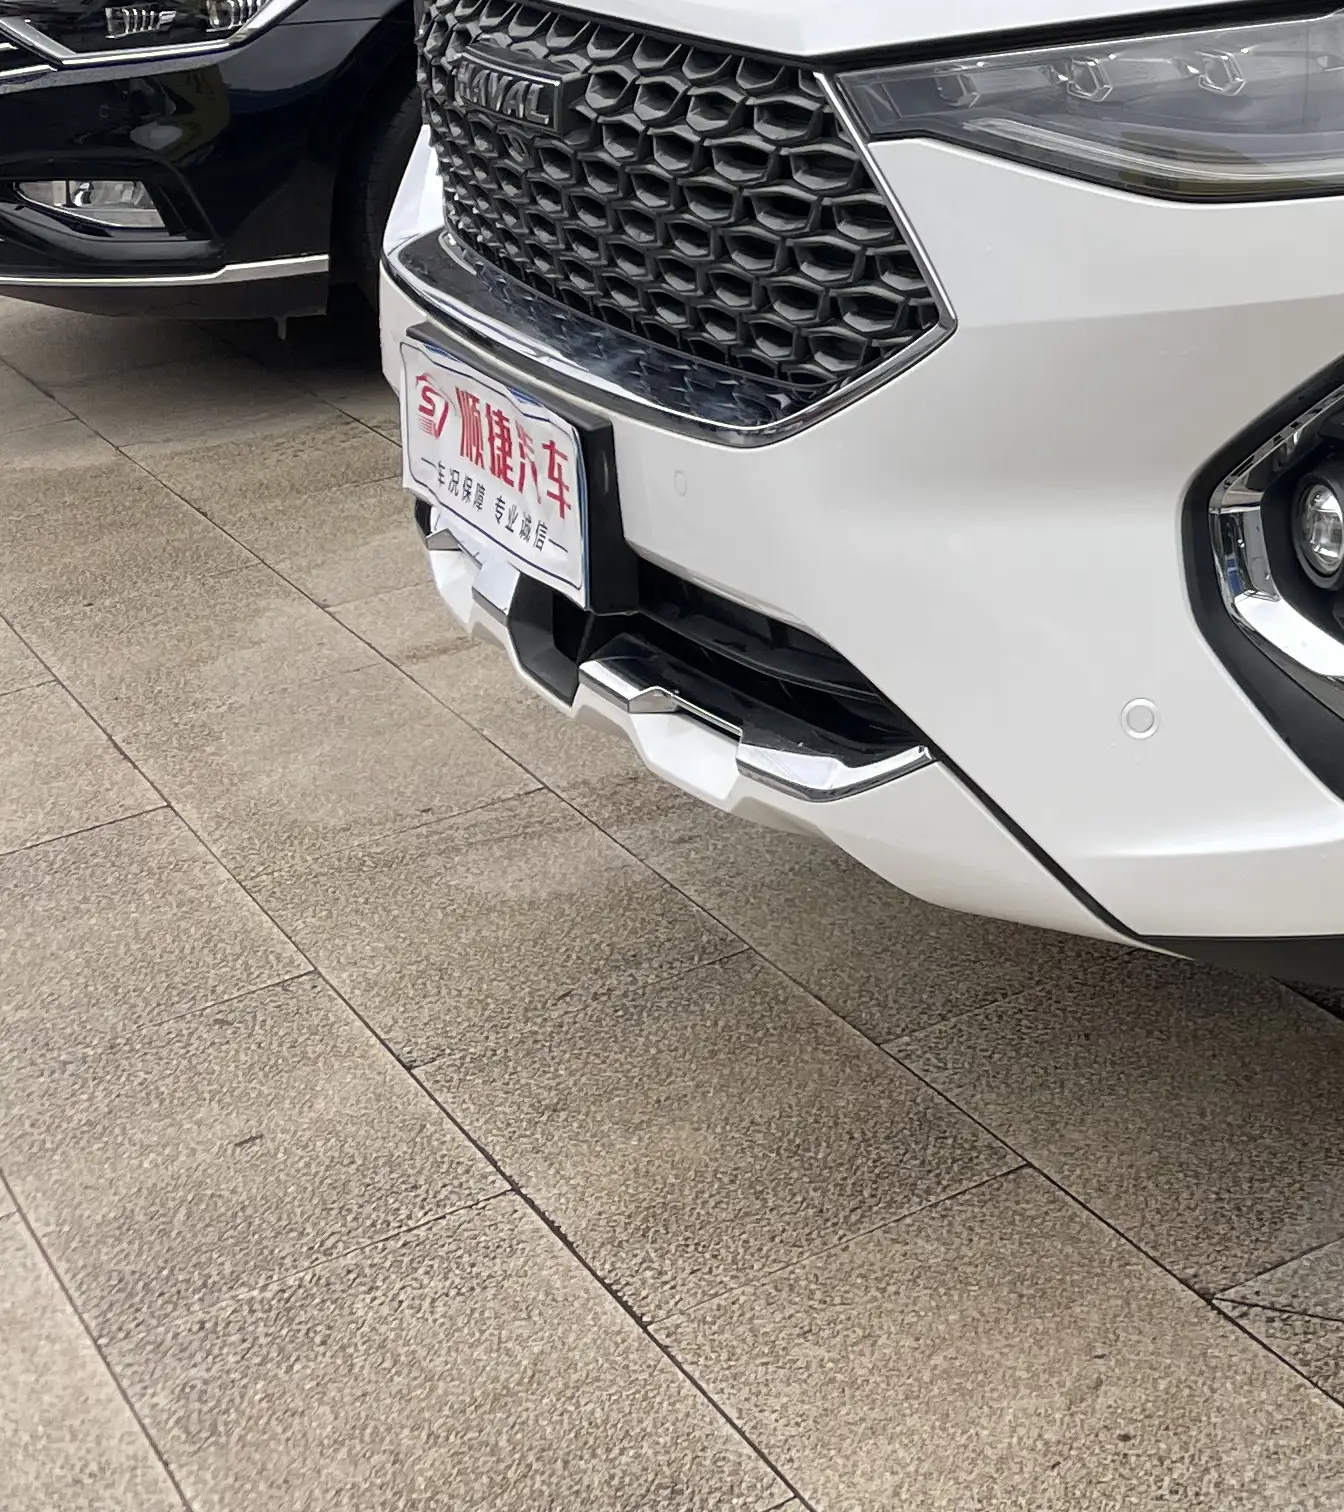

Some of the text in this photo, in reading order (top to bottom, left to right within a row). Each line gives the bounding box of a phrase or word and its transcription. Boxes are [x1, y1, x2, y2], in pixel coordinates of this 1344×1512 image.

[457, 61, 549, 125] HAVAL
[456, 386, 572, 520] 顺捷汽车
[437, 460, 548, 552] 车况保障 专业诚信
